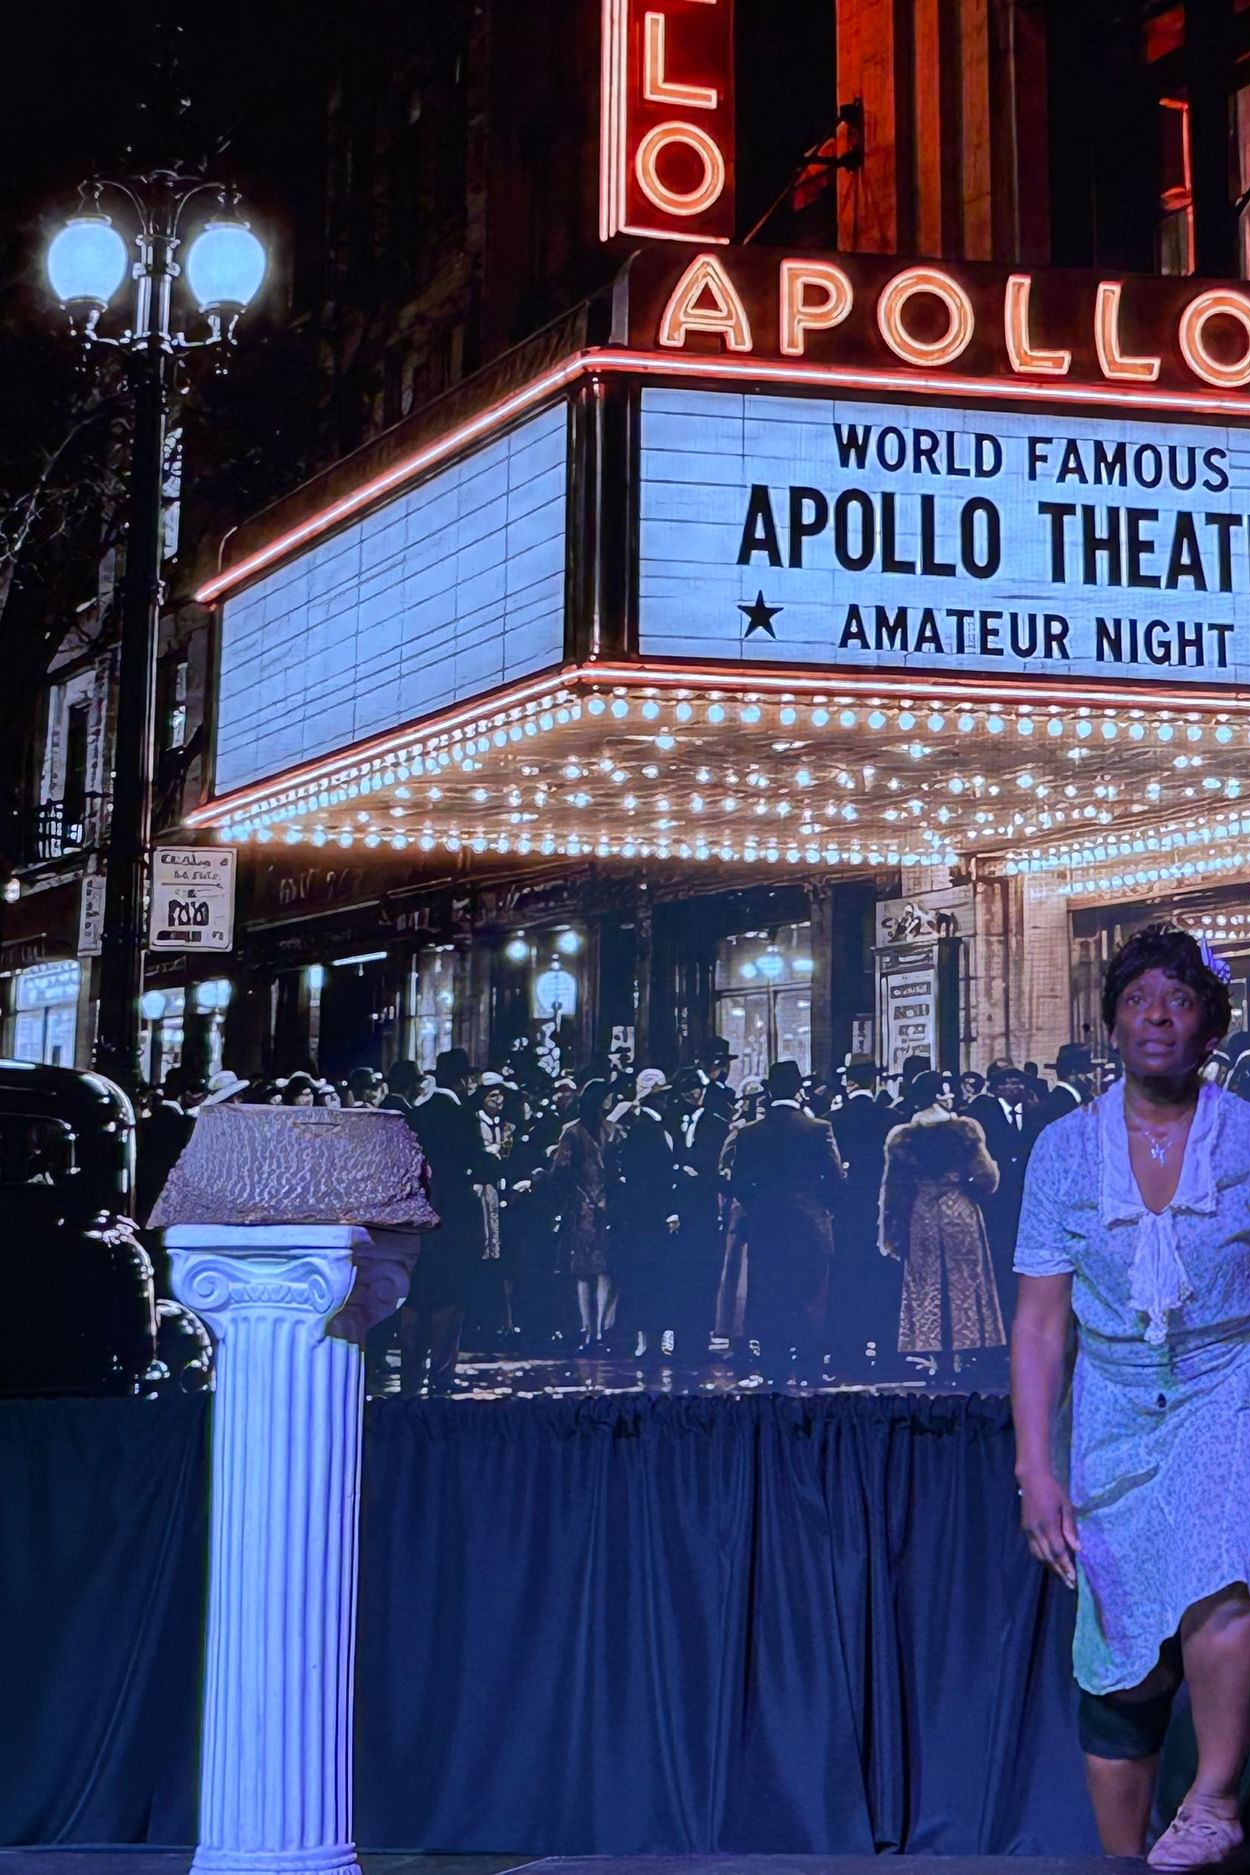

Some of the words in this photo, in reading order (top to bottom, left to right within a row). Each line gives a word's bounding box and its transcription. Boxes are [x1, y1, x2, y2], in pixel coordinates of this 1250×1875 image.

[635, 0, 725, 216] LO
[833, 423, 1003, 479] WORLD
[1028, 436, 1229, 492] FAMOUS
[736, 484, 1001, 579] APOLLO
[839, 604, 1070, 659] AMATEUR
[1095, 616, 1235, 668] NIGHT
